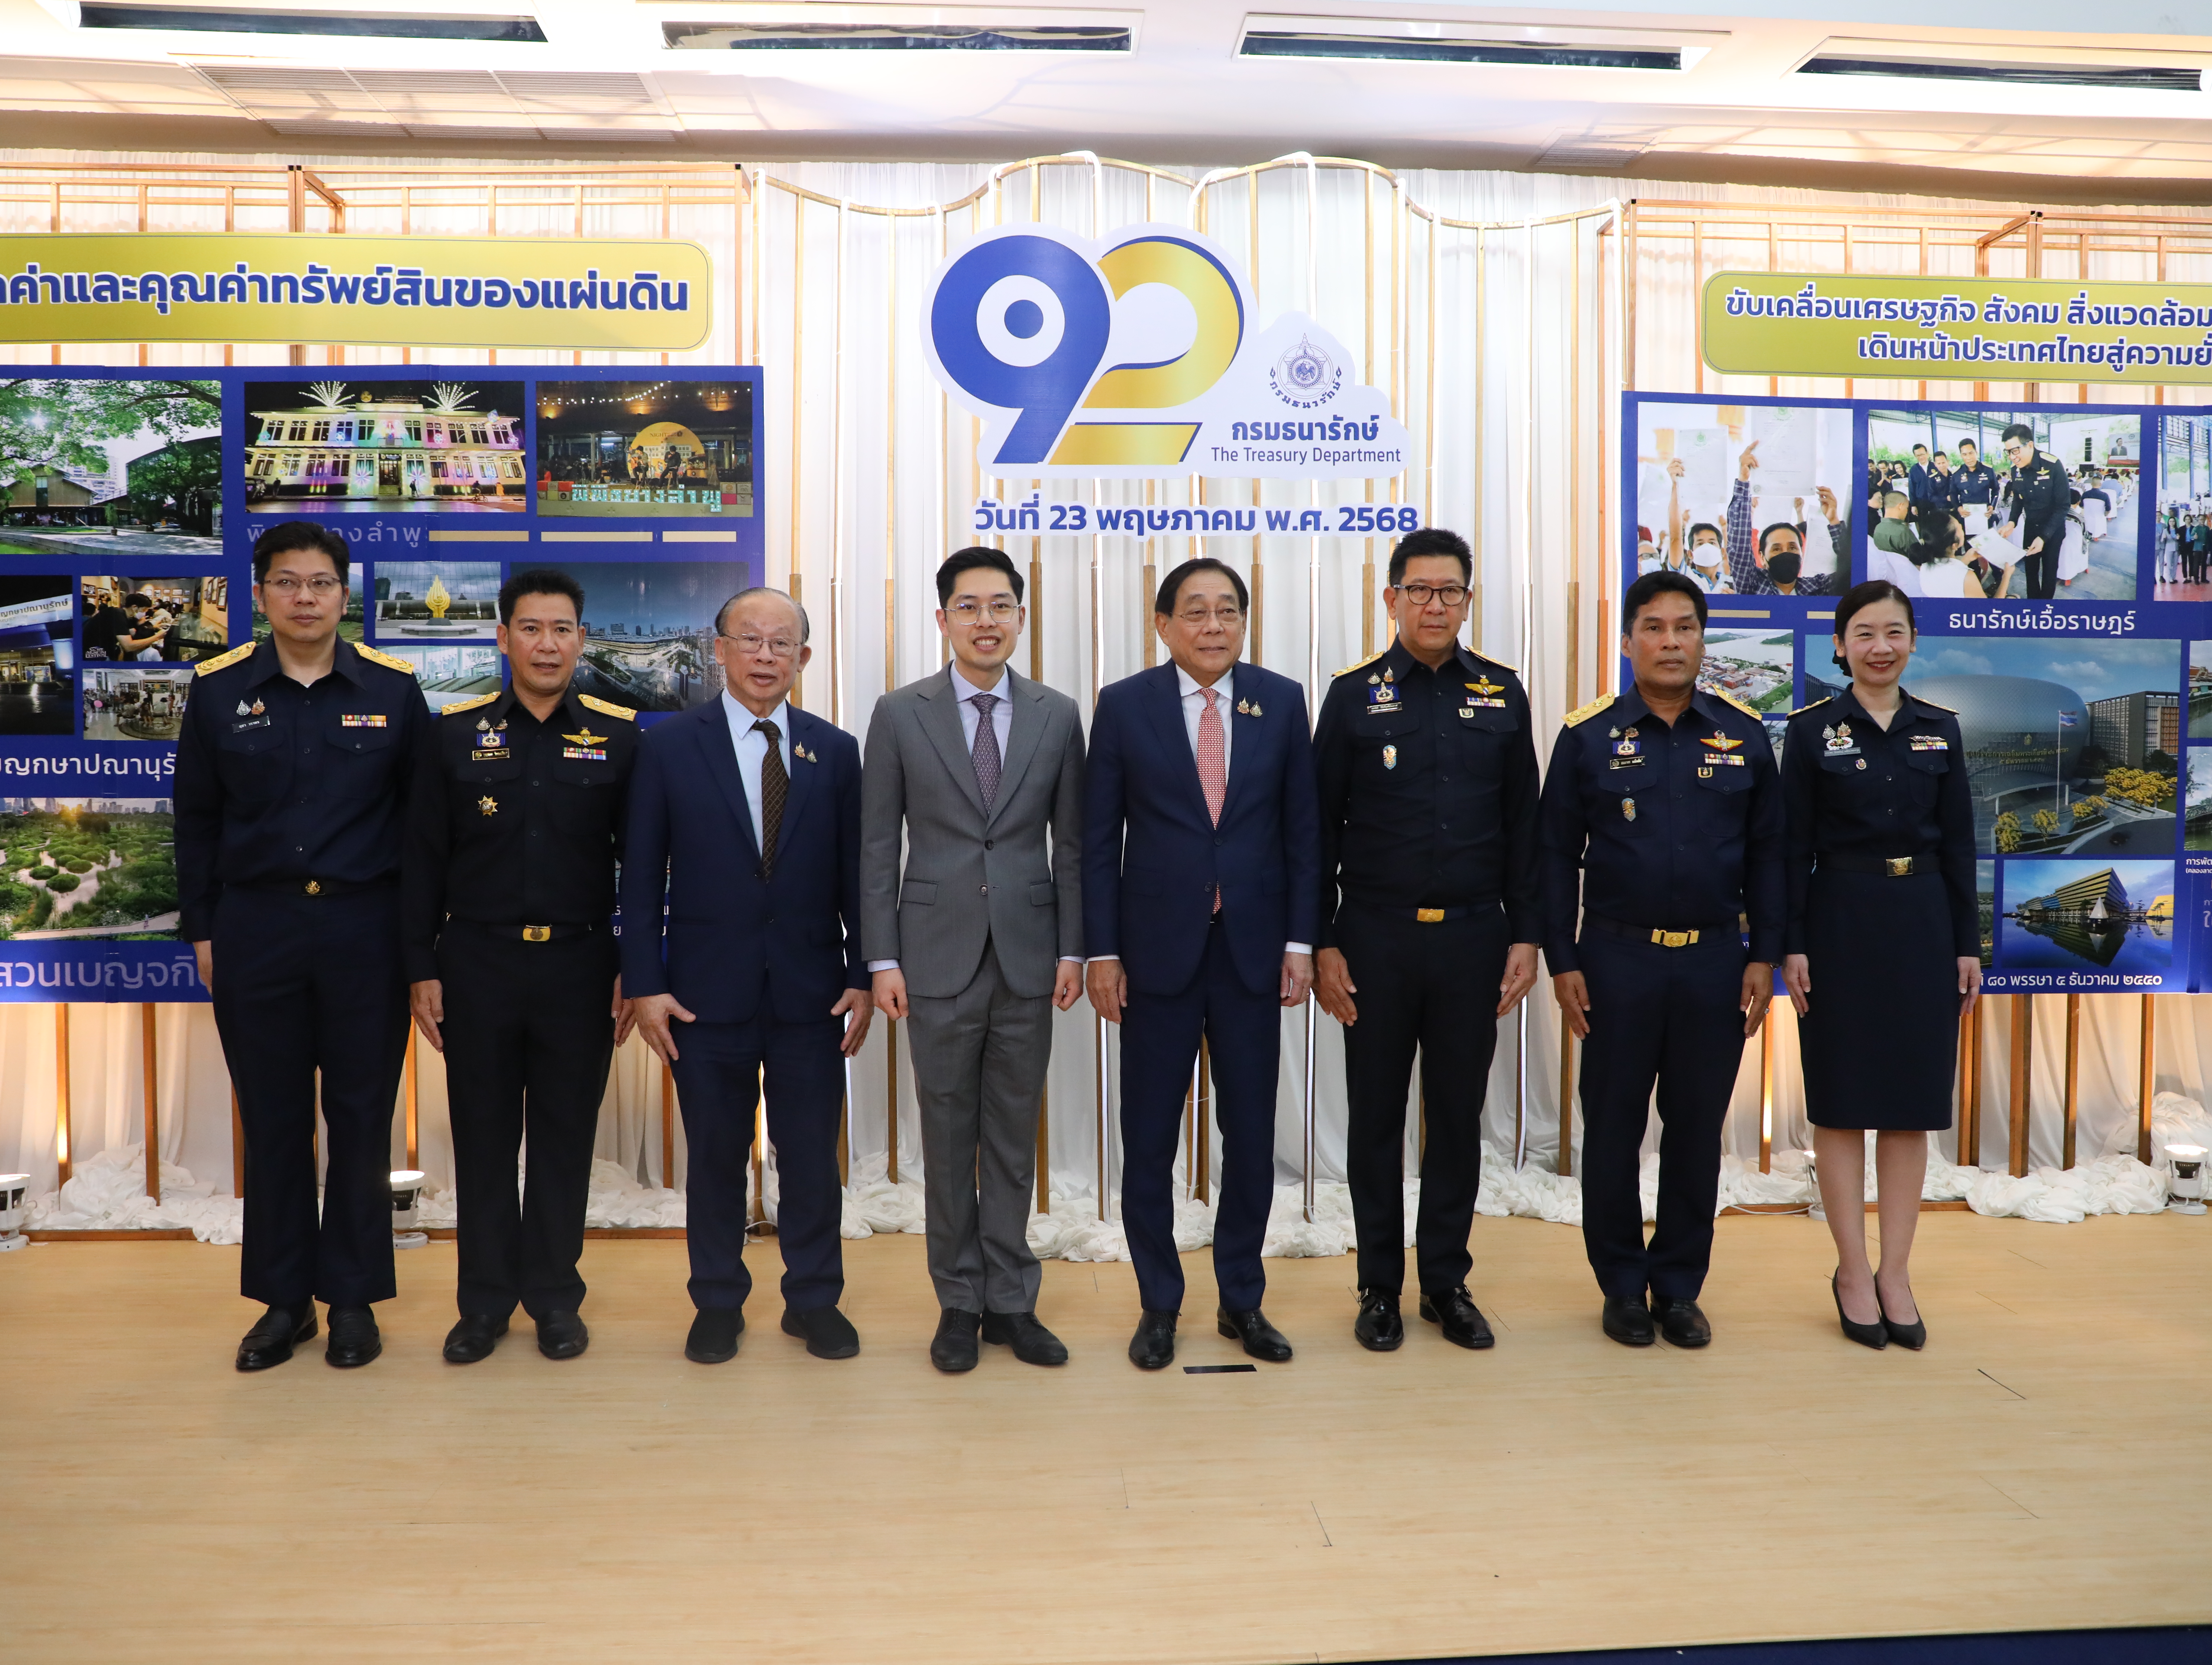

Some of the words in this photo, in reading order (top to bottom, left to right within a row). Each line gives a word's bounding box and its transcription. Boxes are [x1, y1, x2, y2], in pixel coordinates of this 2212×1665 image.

[1727, 284, 1975, 326] ขับเคลื่อนเศรษฐกิจ
[1985, 296, 2059, 324] สังคม
[2067, 292, 2212, 327] สิ่งแวดล้อม
[1270, 378, 1341, 408] กรมธนารักษ์
[1232, 415, 1380, 441] กรมธนารักษ์
[1211, 447, 1238, 462] The
[1244, 447, 1307, 465] Treasury
[1313, 447, 1401, 466] Department
[976, 493, 1039, 530] วันที่
[1050, 505, 1087, 530] 23
[1097, 509, 1255, 536] พฤษภาคม
[1265, 510, 1329, 531] พ.ศ.
[1339, 507, 1418, 532] 2568
[0, 598, 68, 617] ญกษาปณานุรักษ์
[1949, 604, 2136, 635] ธนารักษ์เอื้อราษฎร์
[0, 956, 207, 989] สวนเบญจกิ
[1988, 975, 2006, 986] ๘๐
[2011, 975, 2052, 986] พรรษา
[2056, 976, 2066, 985] ๕
[2069, 971, 2119, 986] ธันวาคม
[2123, 974, 2163, 986] ๒๕๕๐
